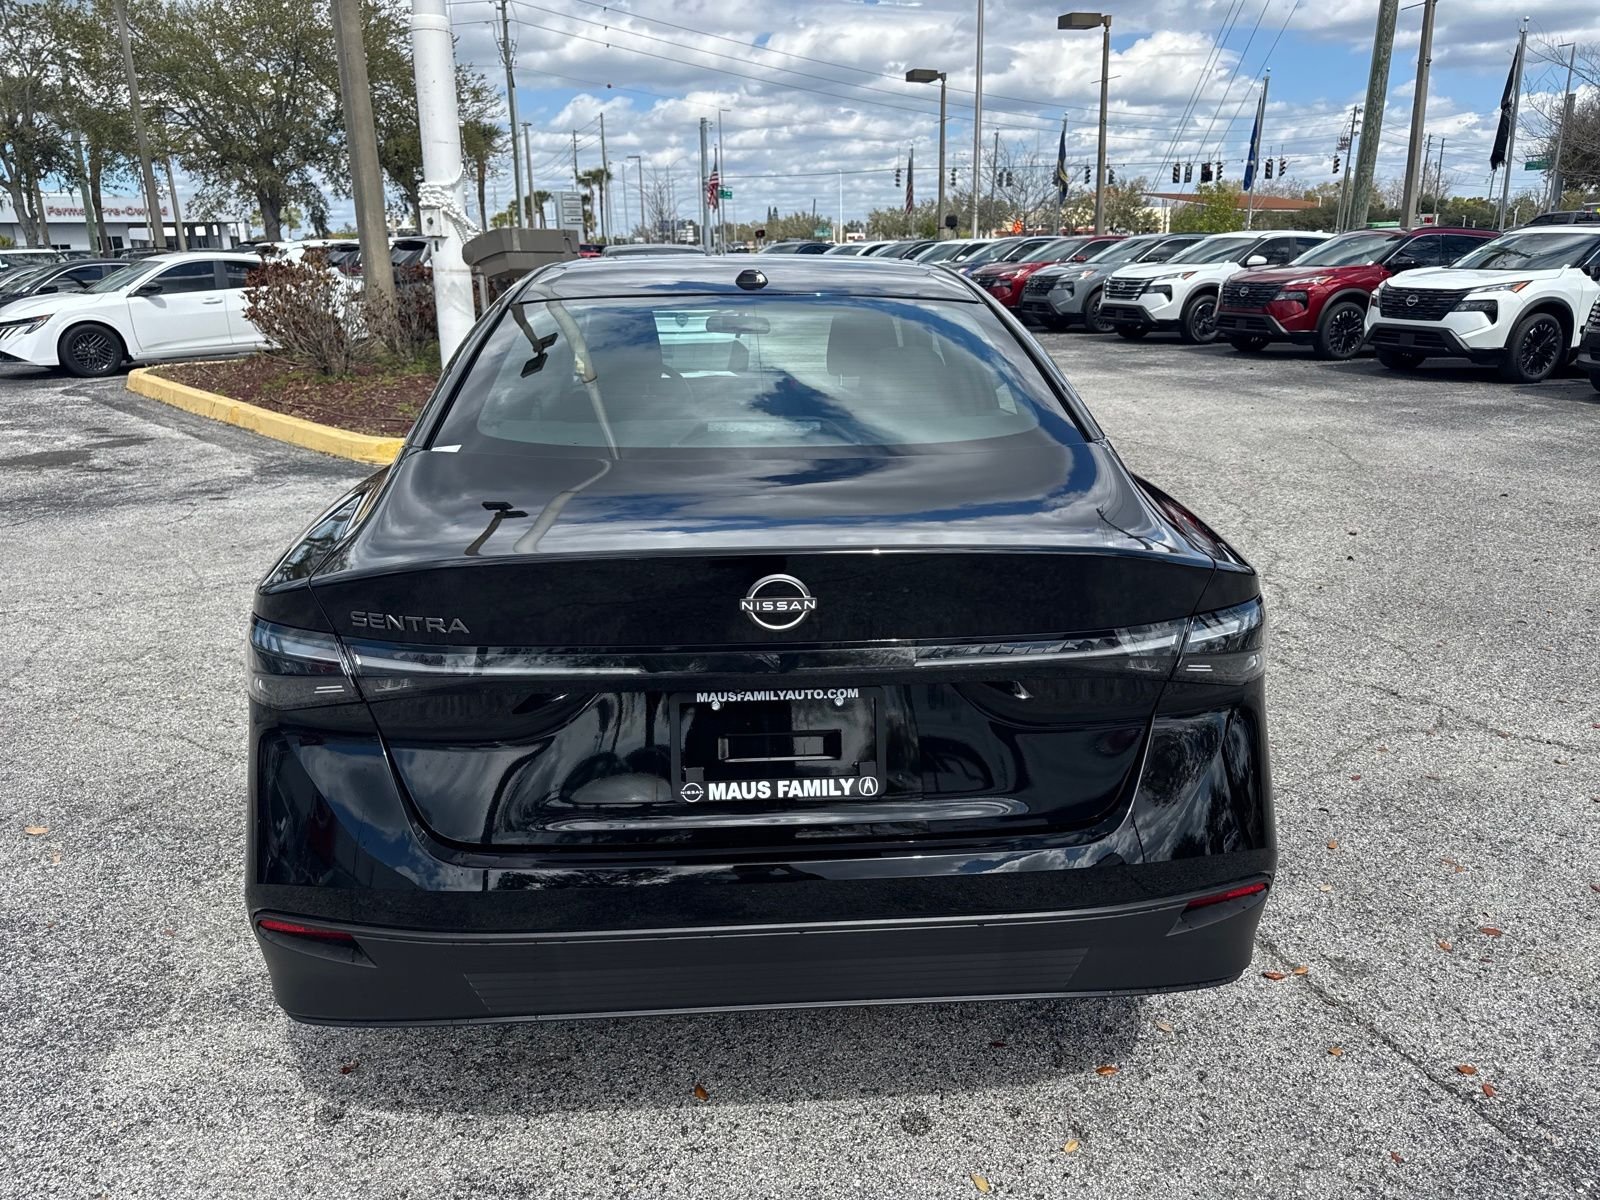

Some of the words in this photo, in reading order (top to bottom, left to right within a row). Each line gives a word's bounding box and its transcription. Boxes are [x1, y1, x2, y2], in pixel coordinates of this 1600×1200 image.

[47, 205, 88, 217] Ferma
[101, 205, 169, 217] Pre-Owd
[741, 600, 816, 611] NISSAN
[350, 610, 471, 634] SENTRA
[696, 688, 859, 703] MAUSFAMILYAUTO.COM
[708, 781, 771, 800] MAUS
[777, 778, 855, 798] FAMILY
